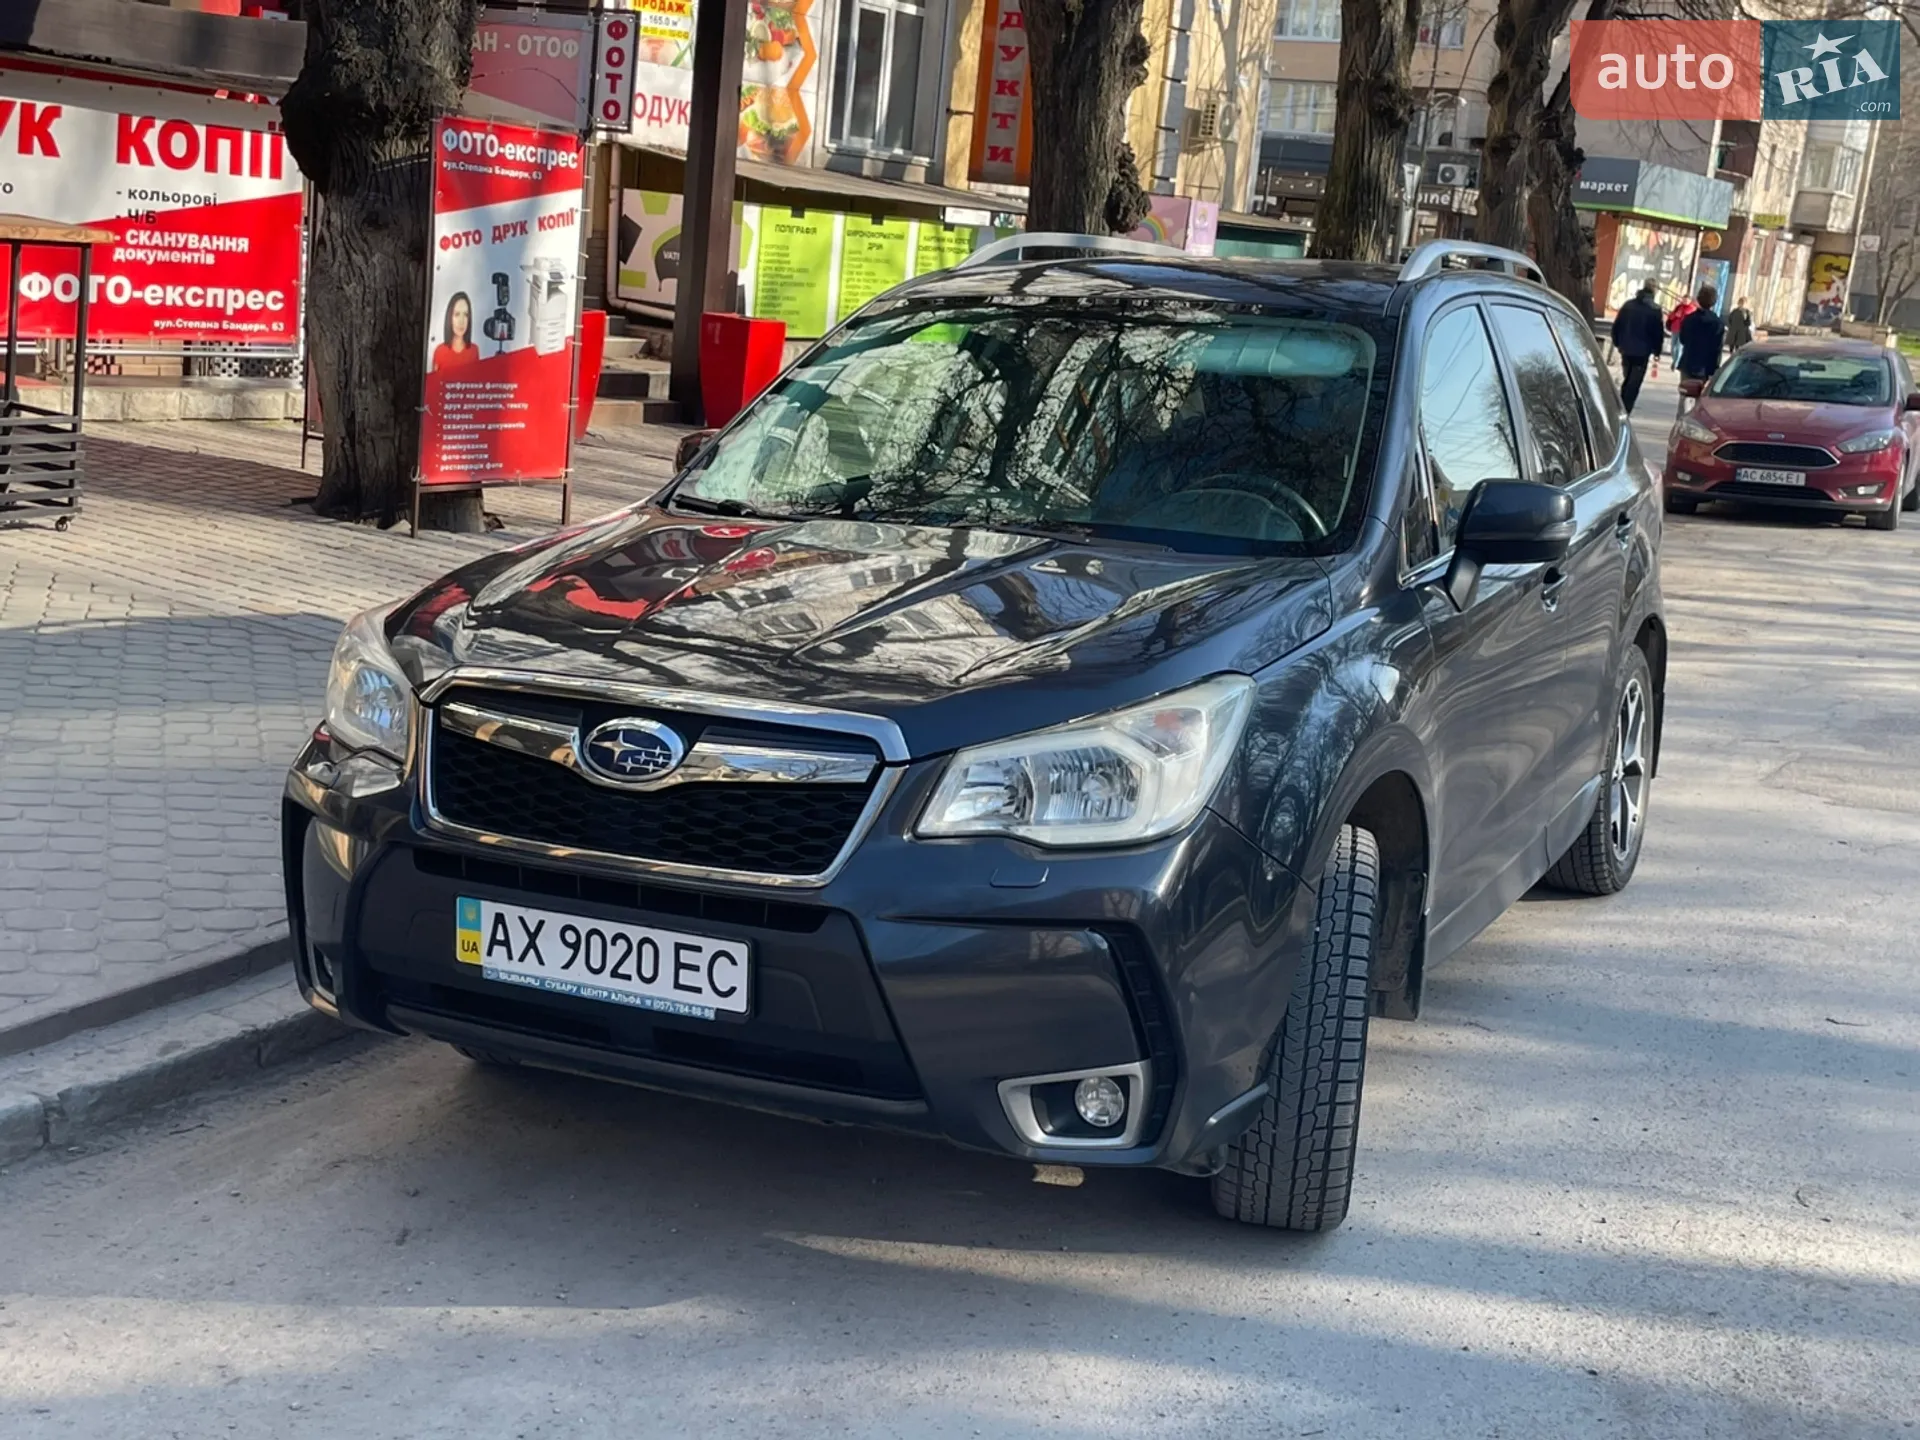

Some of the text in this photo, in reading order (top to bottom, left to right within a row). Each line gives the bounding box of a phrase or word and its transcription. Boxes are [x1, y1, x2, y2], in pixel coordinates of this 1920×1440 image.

[602, 20, 628, 121] ФОТО
[442, 128, 578, 170] ФОТО-експрес
[127, 188, 218, 207] кольорові
[1580, 180, 1630, 193] маркет
[127, 210, 157, 224] Ч/Б
[439, 208, 576, 251] ФОТО ДРУК КОПІЇ
[125, 230, 250, 253] СКАНУВАННЯ
[113, 246, 216, 266] документів
[19, 272, 285, 315] ФОТО-експрес
[461, 939, 480, 955] UA
[486, 912, 739, 998] AX 9020 EC
[499, 971, 540, 986] SUBARU
[545, 980, 578, 993] СУБАРУ
